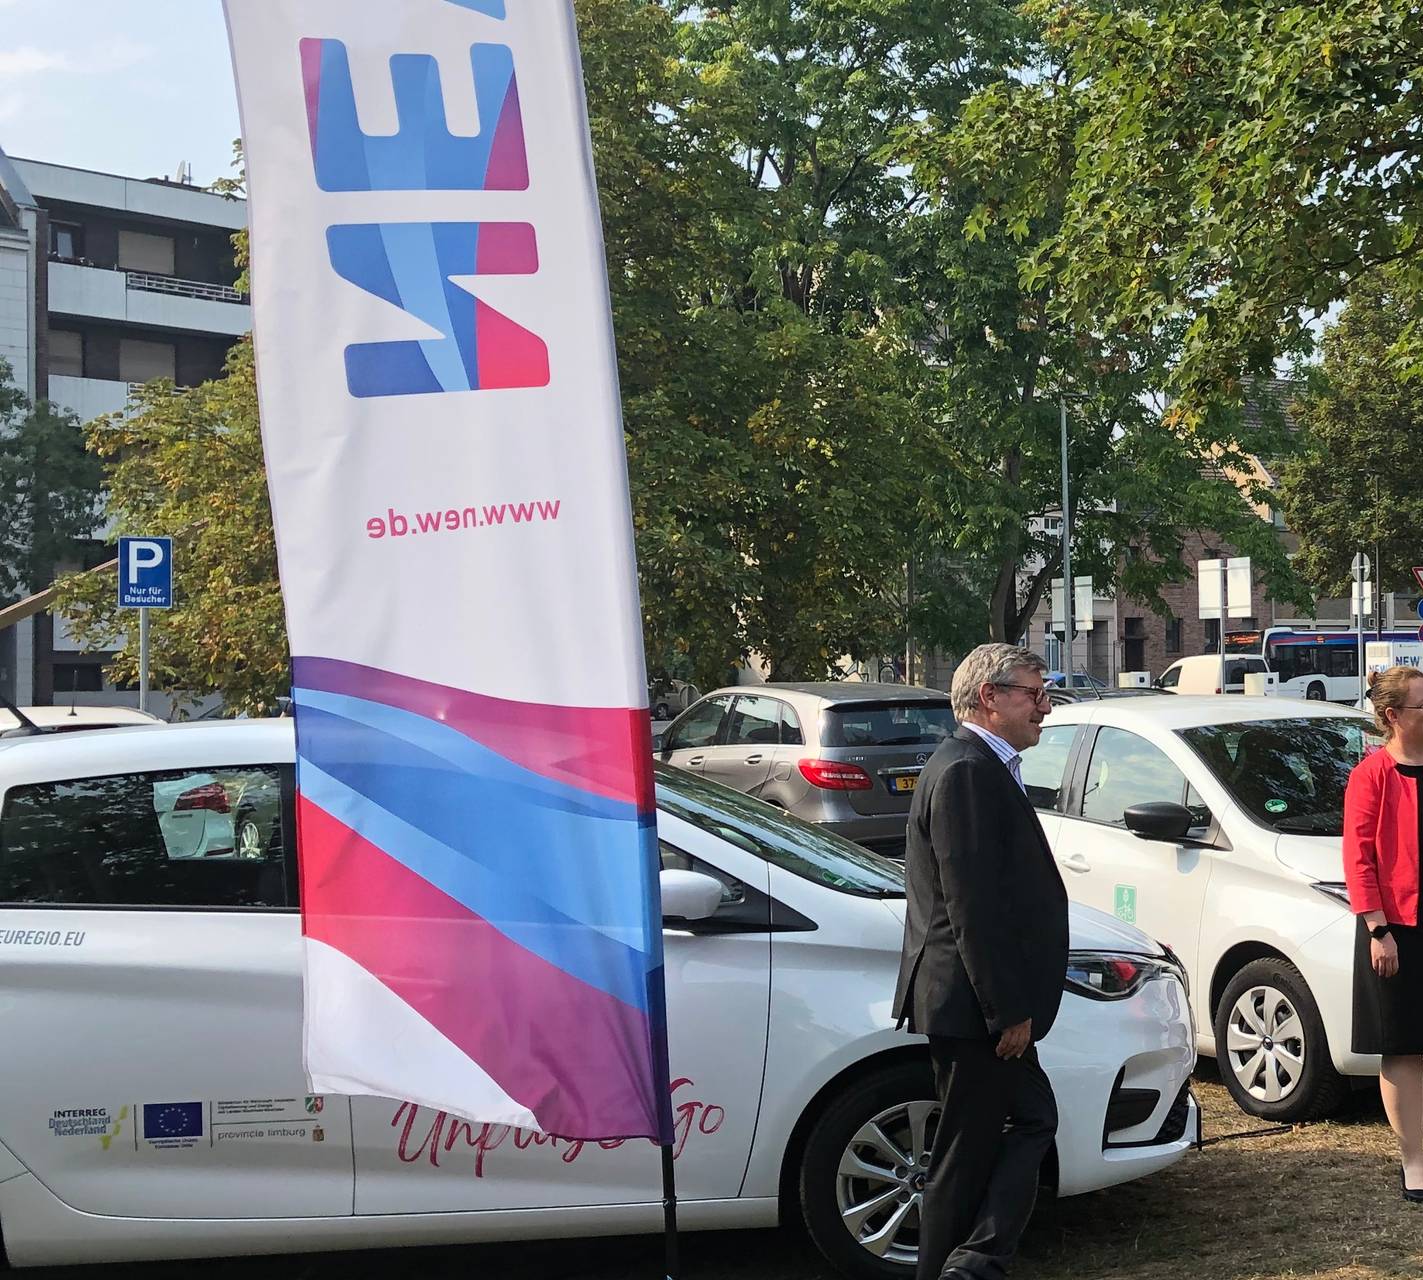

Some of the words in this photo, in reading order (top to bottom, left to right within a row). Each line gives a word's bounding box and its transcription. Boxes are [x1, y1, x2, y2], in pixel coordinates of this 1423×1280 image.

[128, 540, 164, 584] P
[129, 586, 146, 595] Nur
[148, 586, 162, 595] für
[124, 594, 167, 603] Besucher
[53, 1108, 107, 1119] INTERREG
[48, 1115, 111, 1128] Deutschland
[54, 1125, 107, 1137] Nederland
[217, 1130, 264, 1141] provincie
[267, 1127, 306, 1138] limburg
